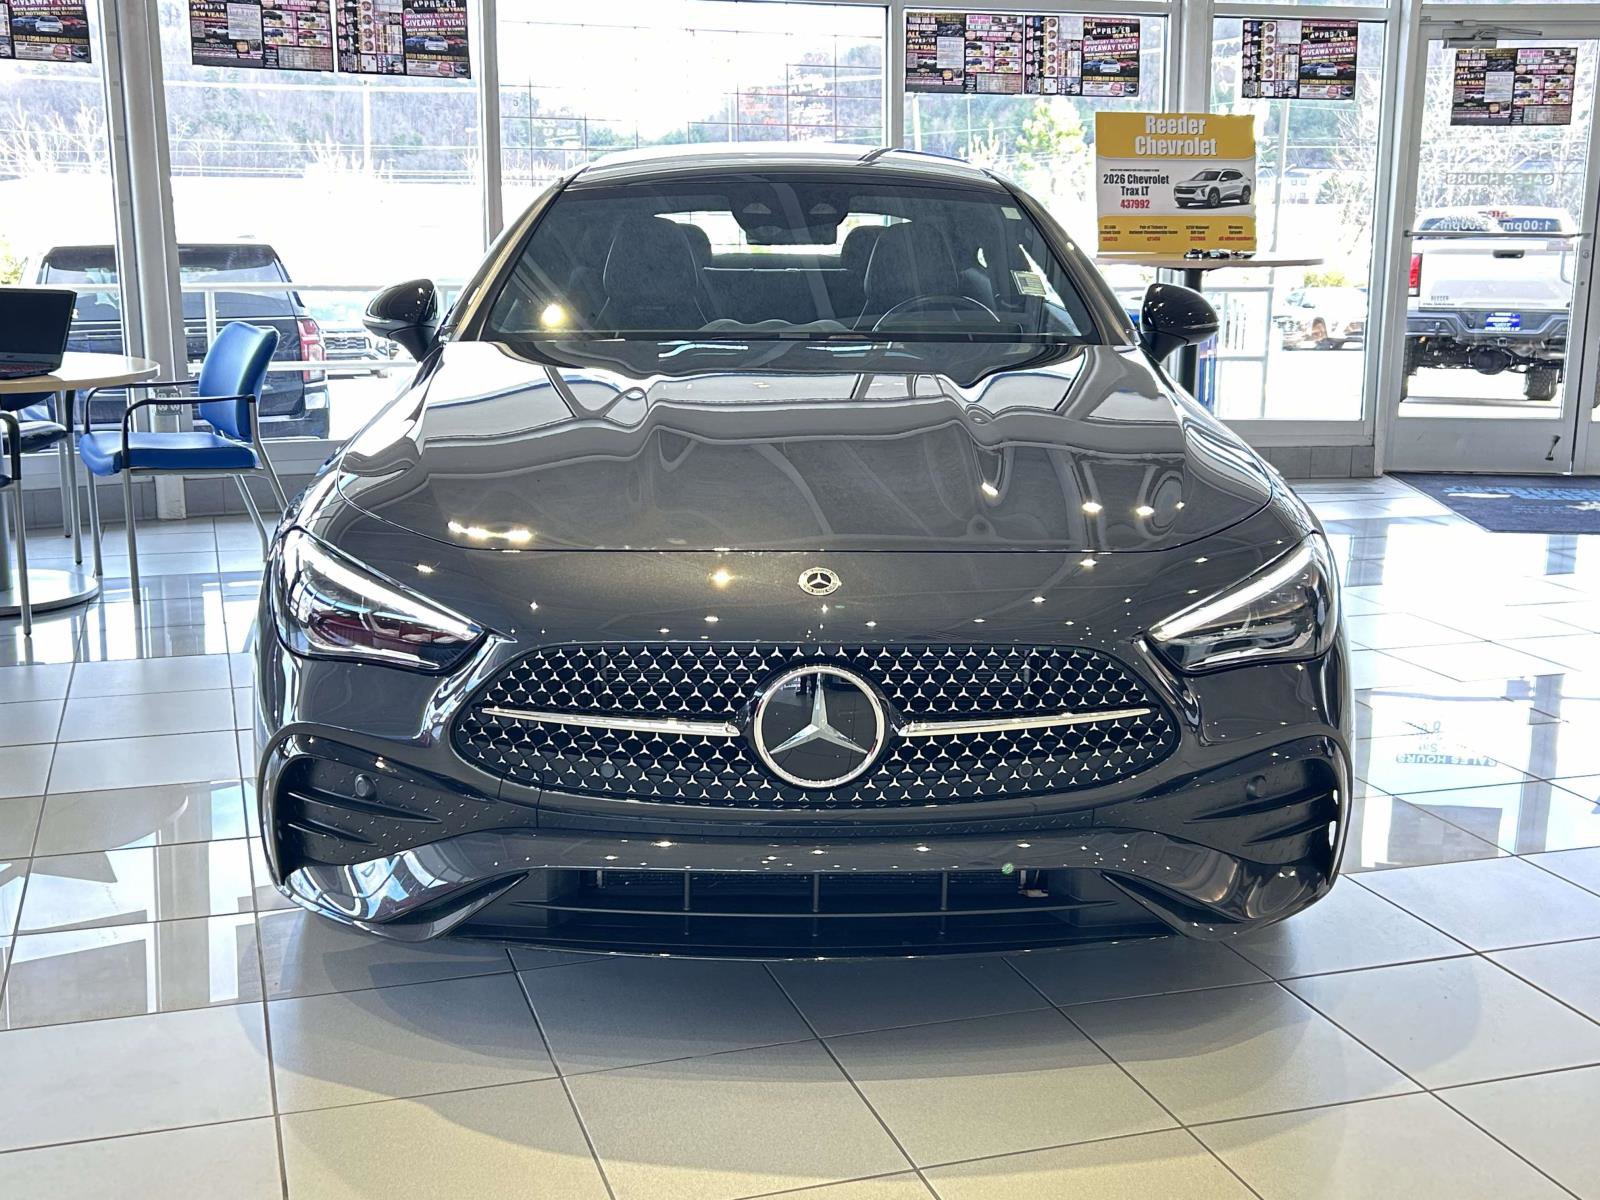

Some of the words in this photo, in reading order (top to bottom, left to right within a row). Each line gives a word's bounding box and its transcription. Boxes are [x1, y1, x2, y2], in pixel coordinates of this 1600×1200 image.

[1145, 115, 1206, 135] Reeder
[1135, 136, 1217, 156] Chevrolet
[1104, 174, 1125, 184] 2026
[1128, 174, 1169, 184] Chevrolet
[1121, 186, 1140, 196] Trax
[1140, 186, 1149, 196] LT
[1120, 200, 1150, 209] 437992
